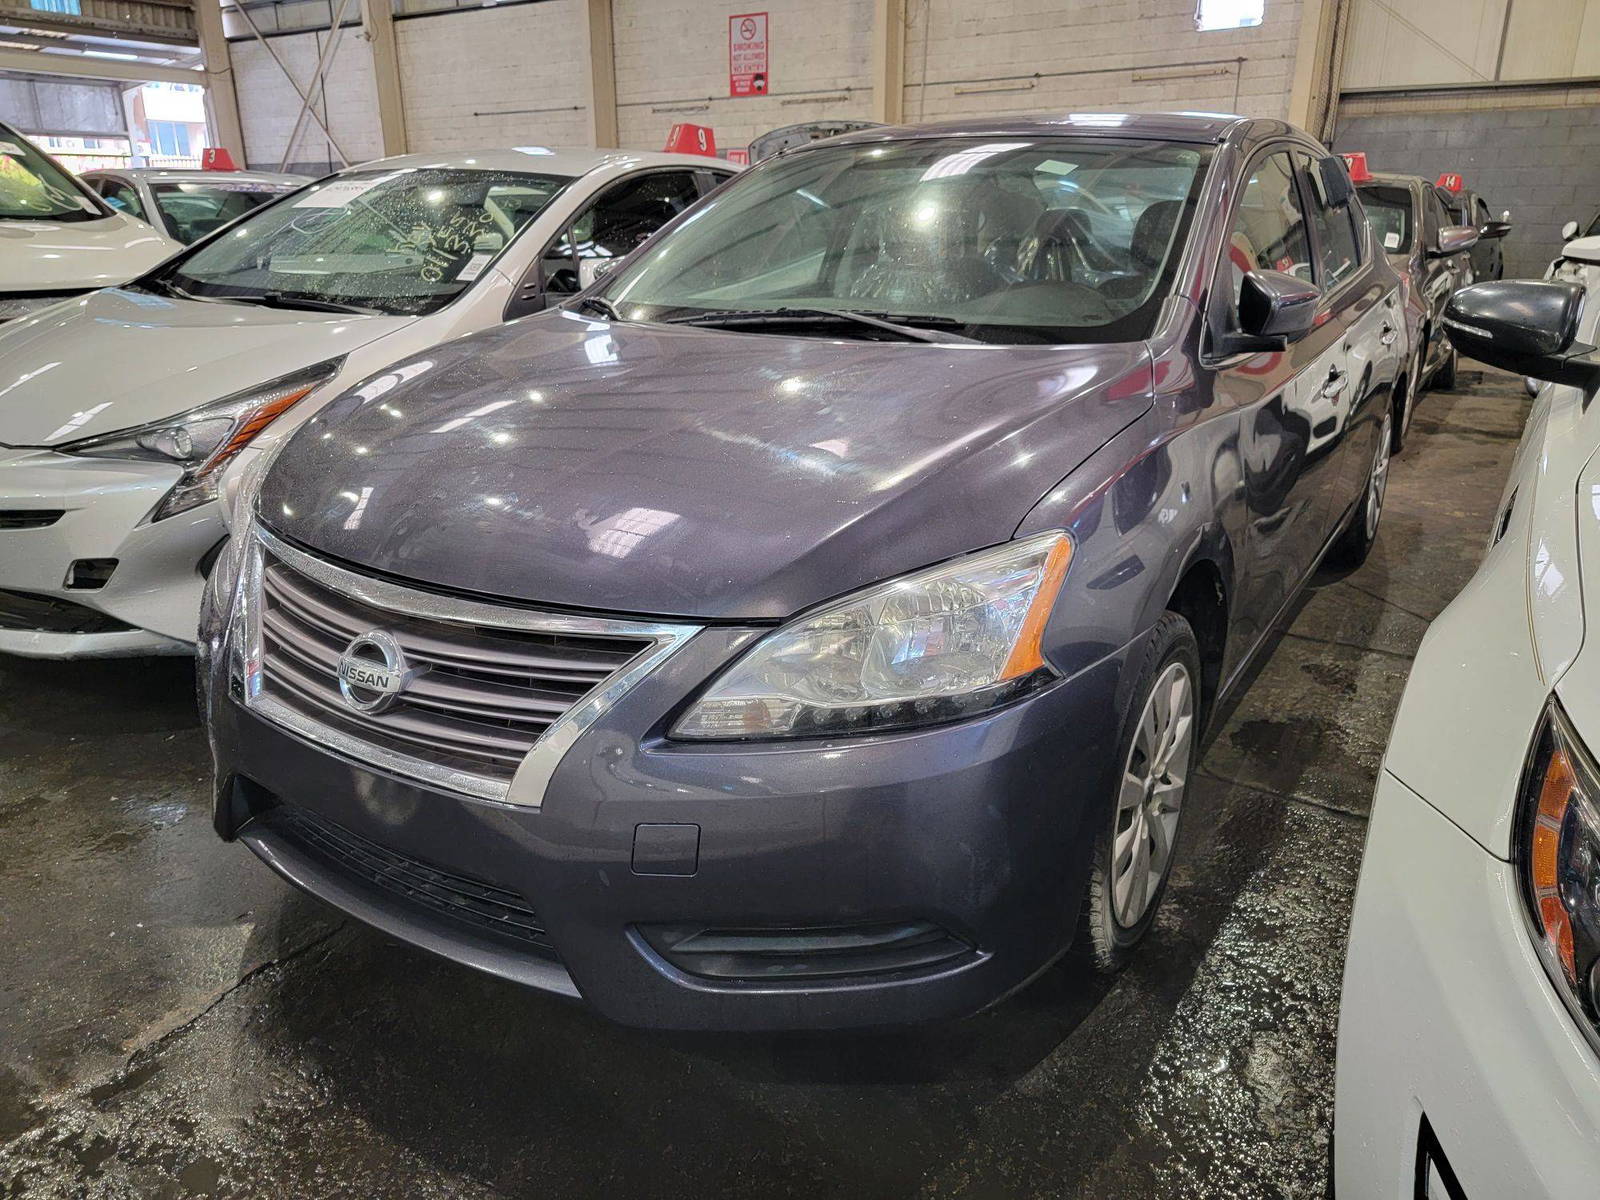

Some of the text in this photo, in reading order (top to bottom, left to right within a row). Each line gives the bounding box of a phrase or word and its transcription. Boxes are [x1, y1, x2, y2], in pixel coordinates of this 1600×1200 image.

[733, 41, 765, 51] SMOKING
[698, 128, 707, 152] 9
[209, 149, 216, 164] 3
[1445, 175, 1456, 187] 14
[339, 660, 389, 688] NISSAN
